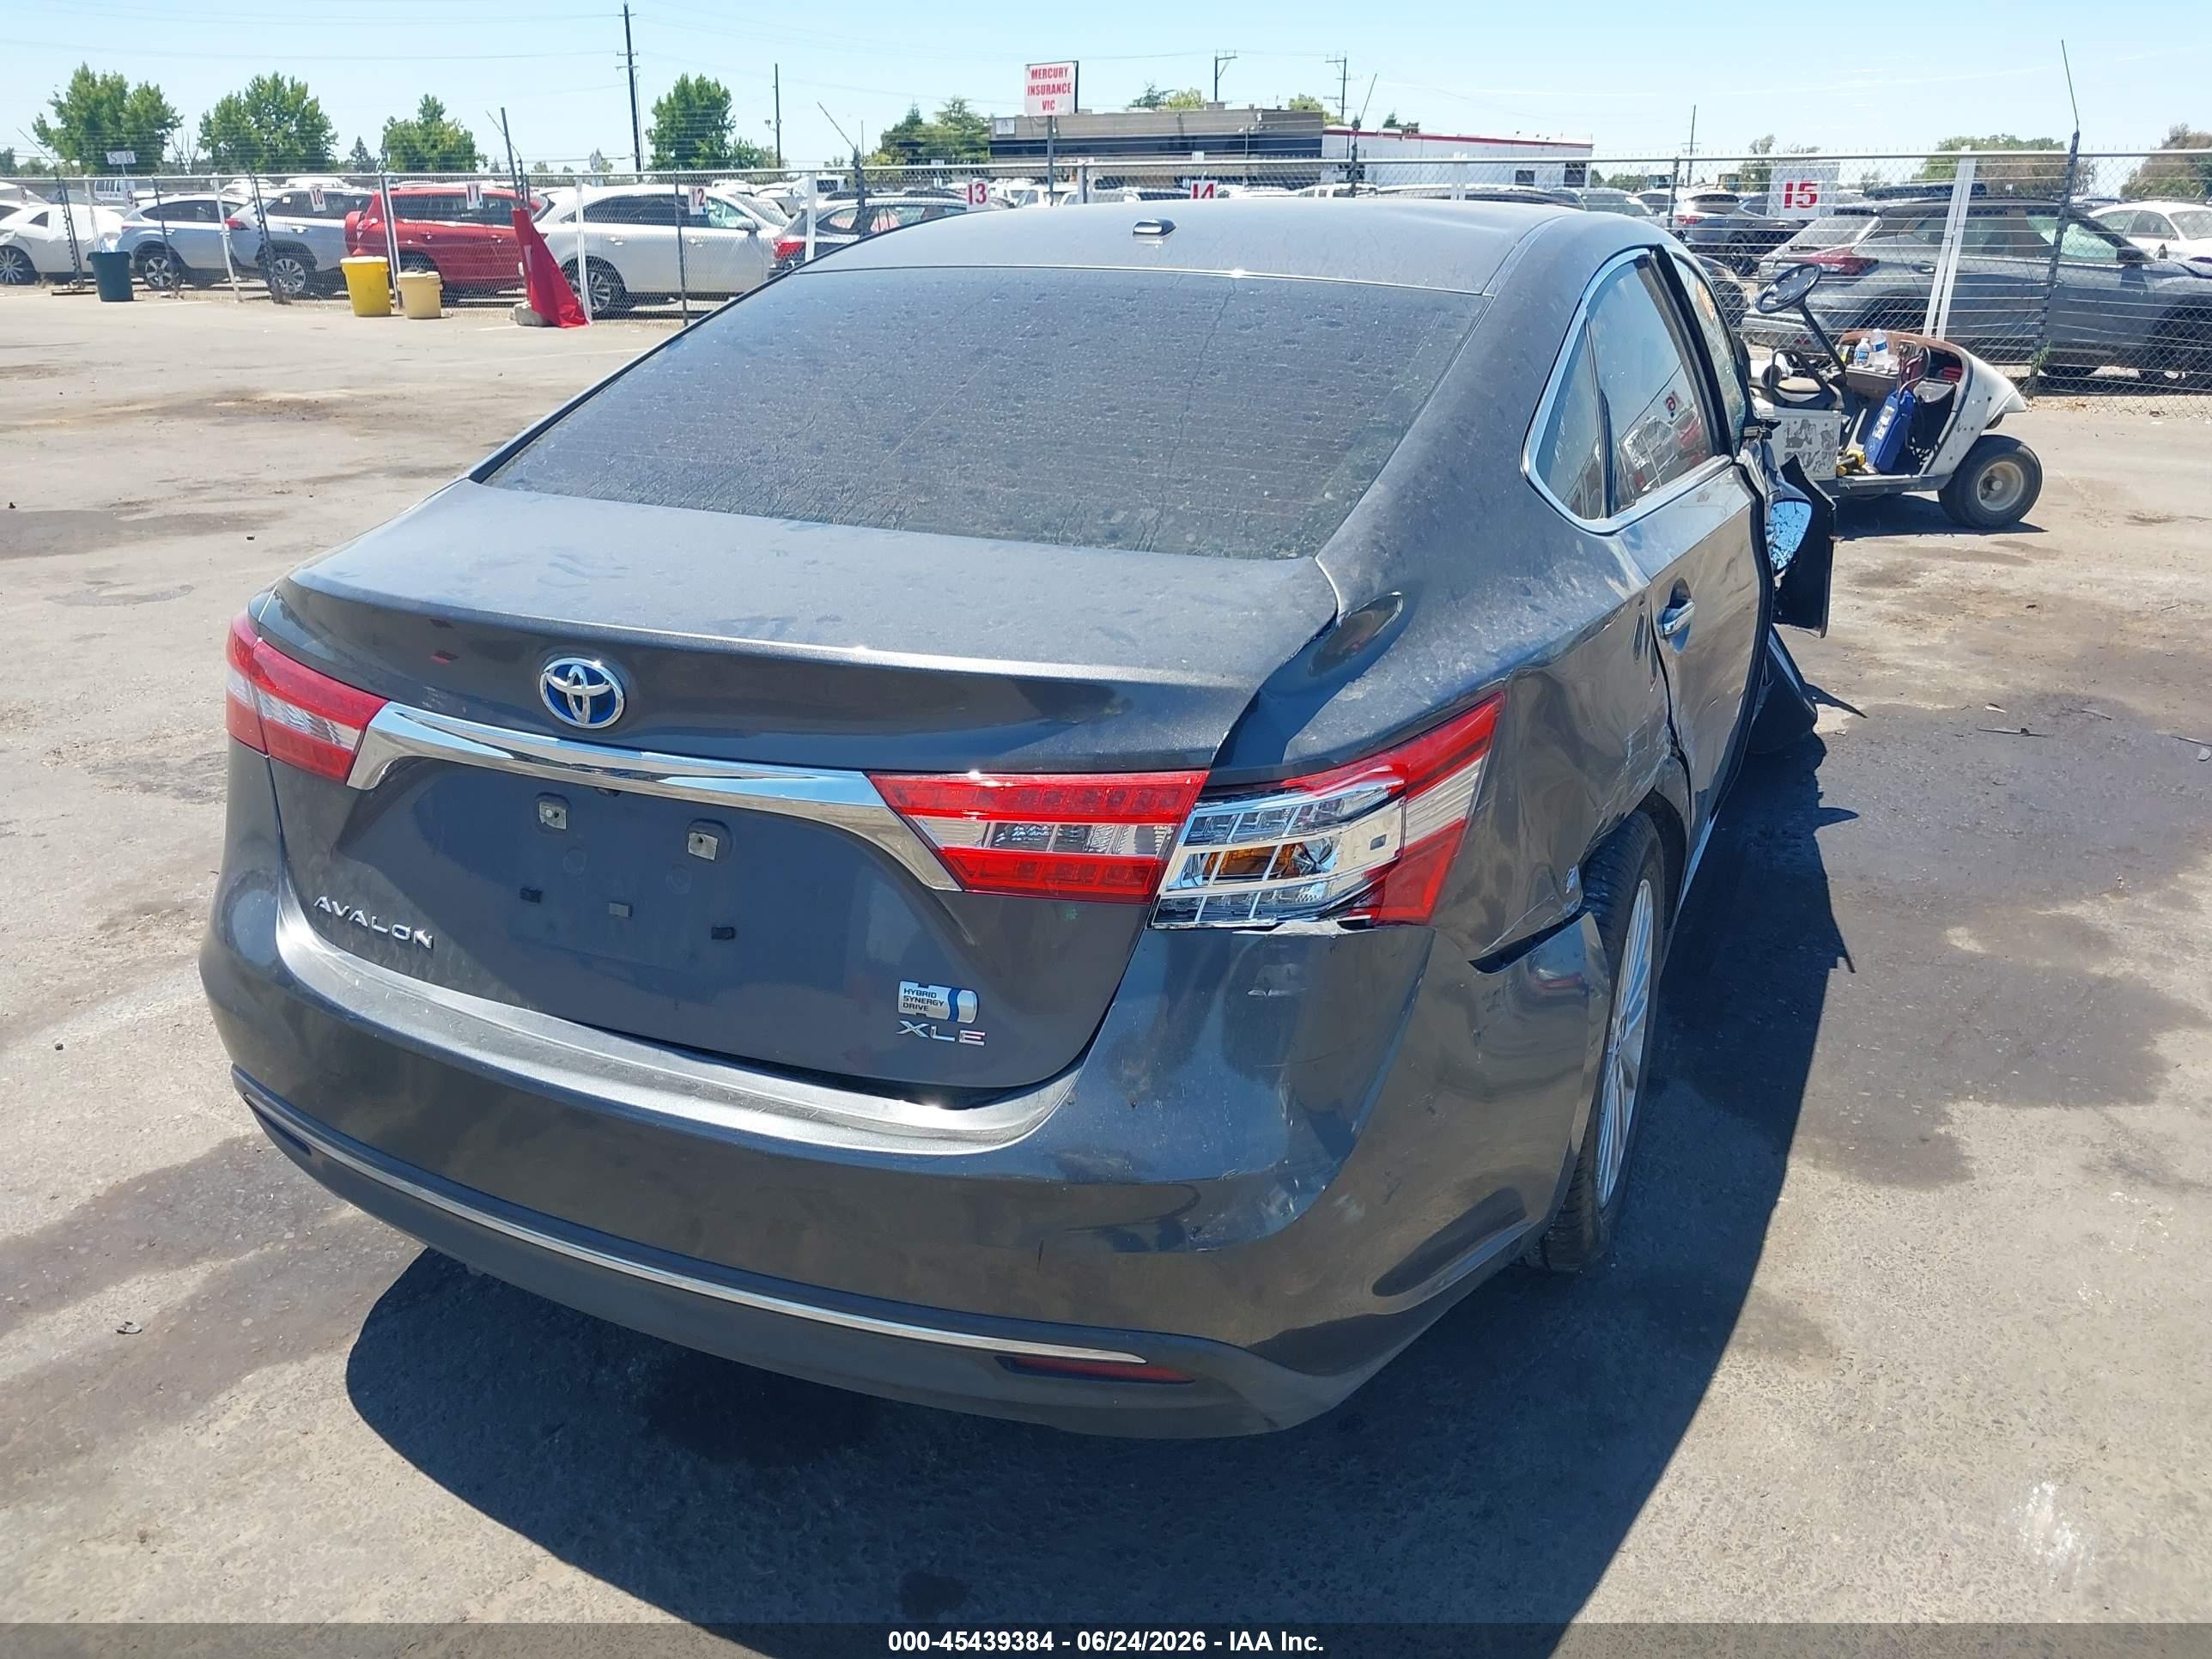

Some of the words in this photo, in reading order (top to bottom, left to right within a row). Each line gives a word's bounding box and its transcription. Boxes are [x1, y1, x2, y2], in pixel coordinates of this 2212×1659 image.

[1031, 67, 1068, 80] MERCURY
[1027, 83, 1071, 96] INSURANCE
[1042, 100, 1055, 111] VIC
[313, 189, 323, 205] 10
[692, 188, 705, 206] 12
[968, 183, 987, 206] 13
[1784, 182, 1818, 209] 15
[313, 896, 433, 949] AVALON
[902, 994, 945, 1007] SYNERGY
[903, 988, 937, 999] HYBRID
[902, 1002, 929, 1012] DRIVE
[896, 1020, 986, 1046] XLE
